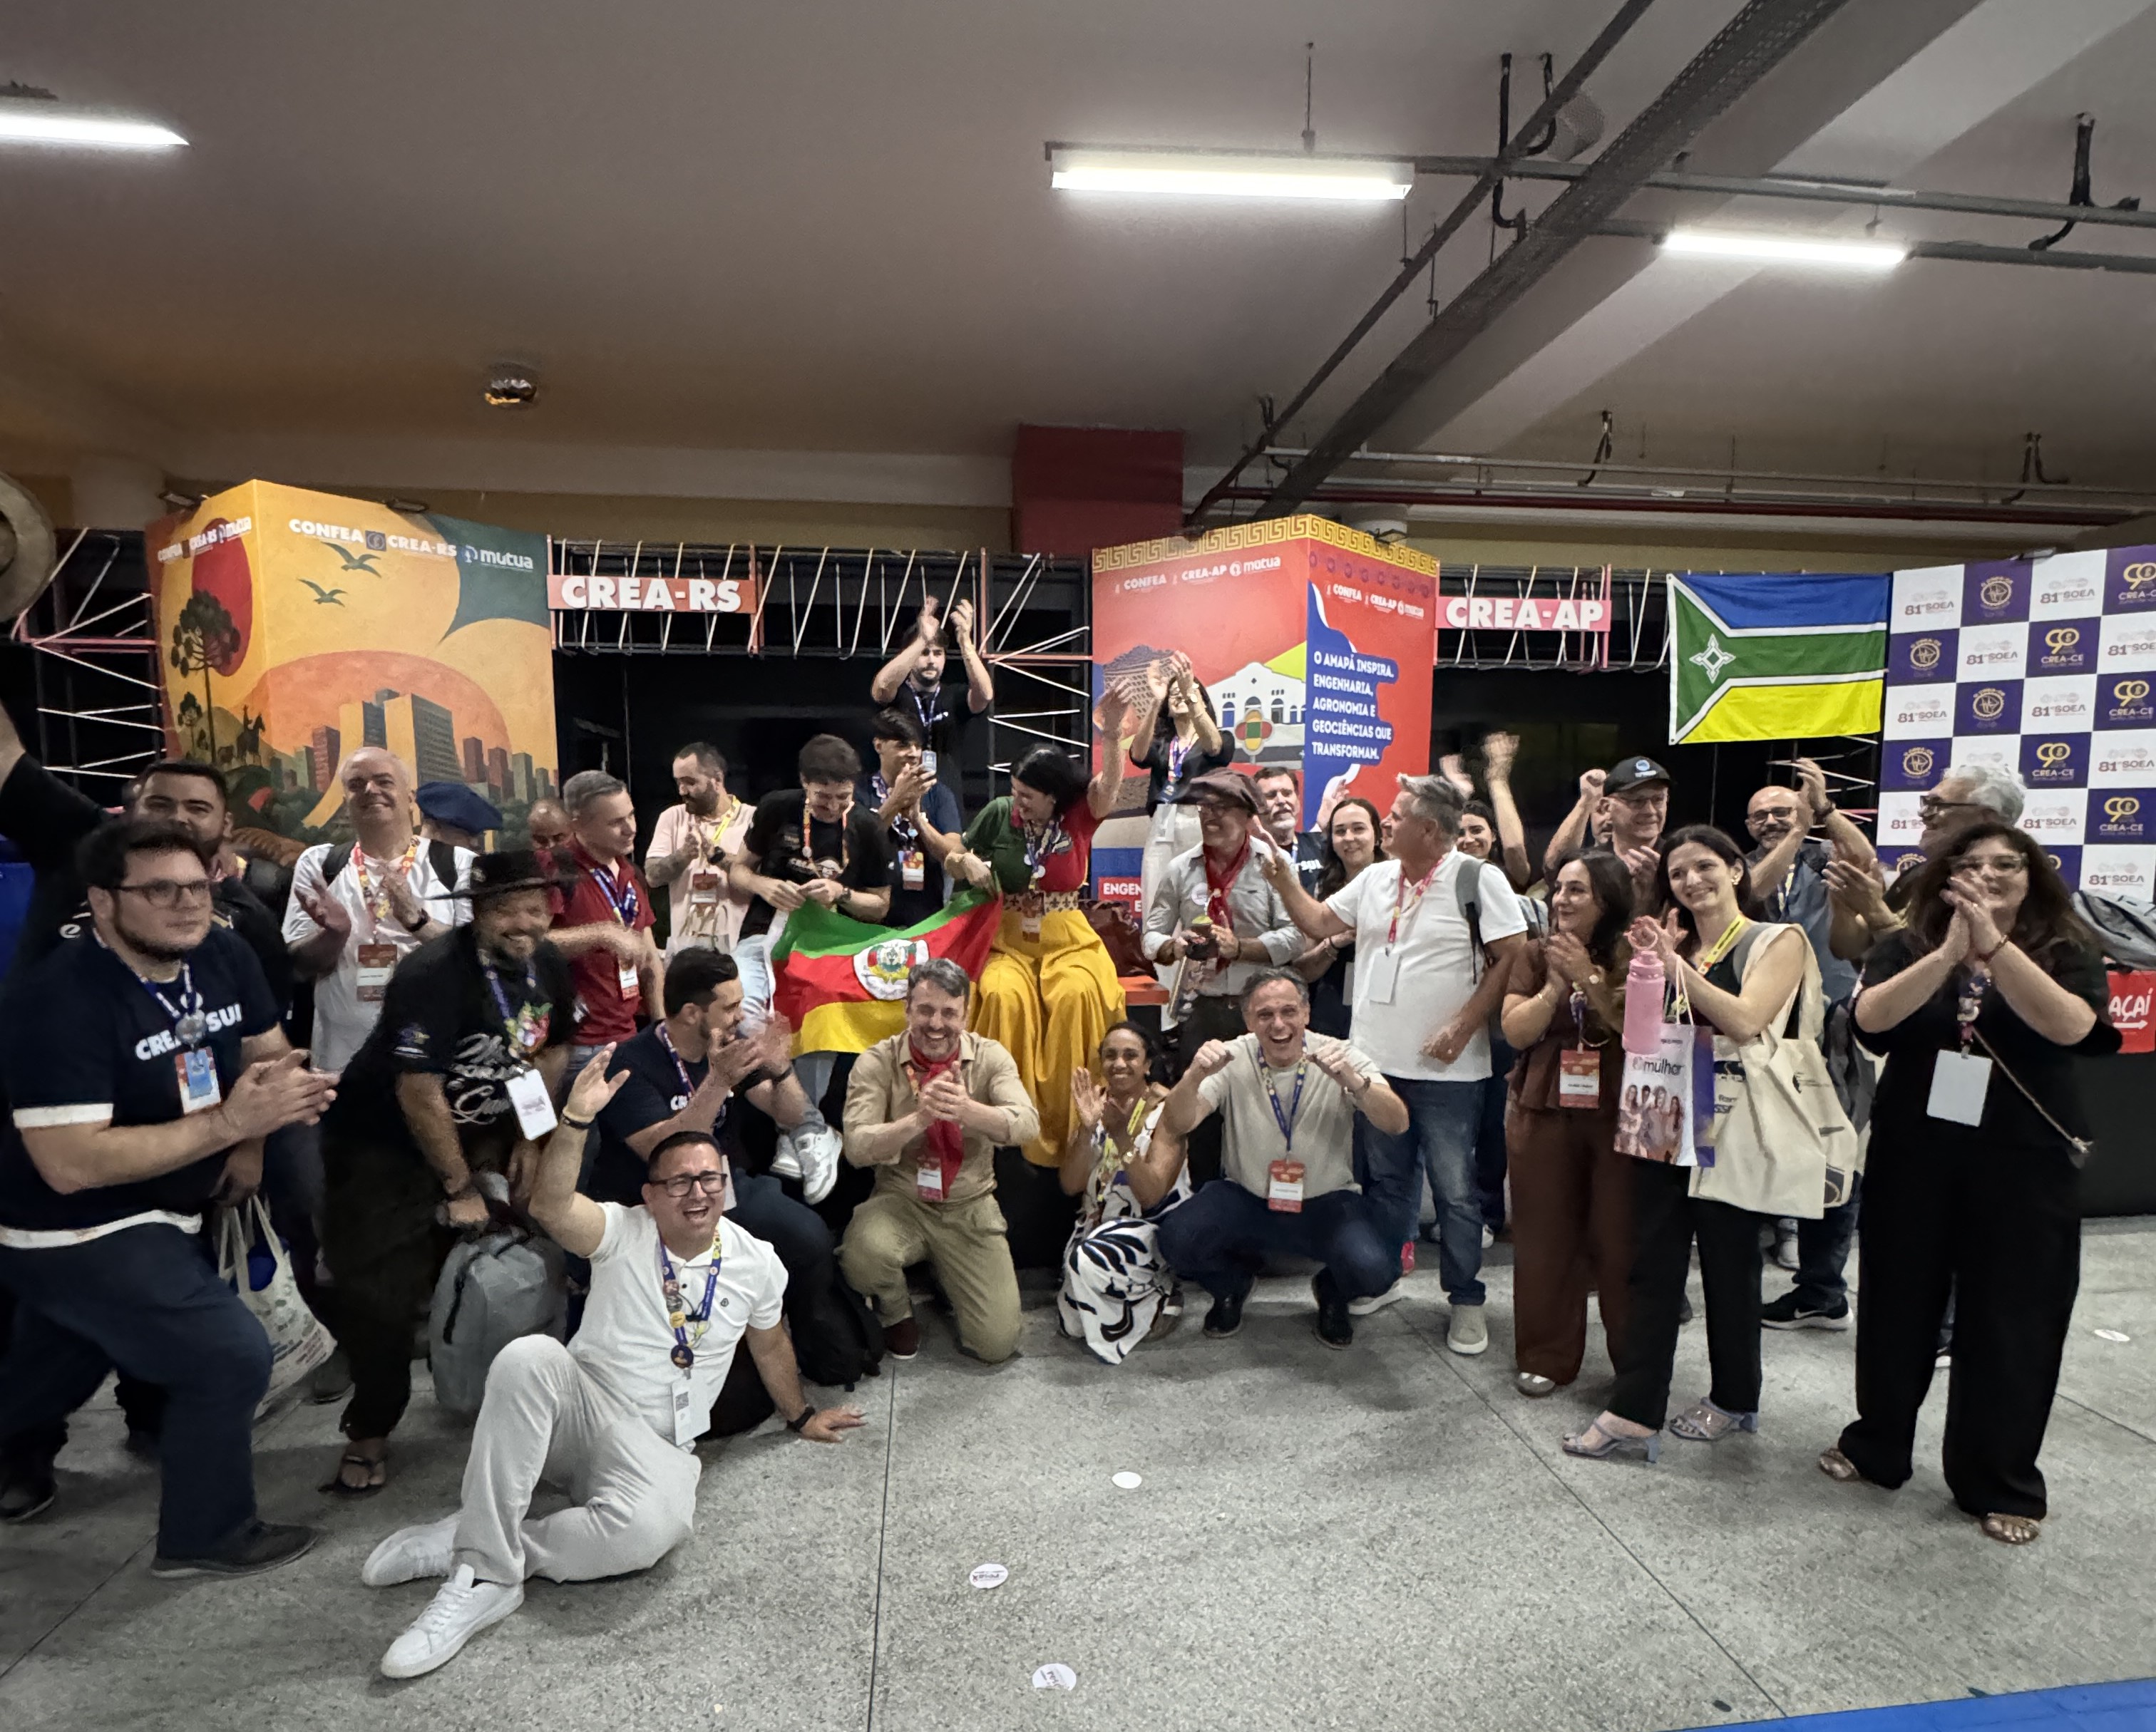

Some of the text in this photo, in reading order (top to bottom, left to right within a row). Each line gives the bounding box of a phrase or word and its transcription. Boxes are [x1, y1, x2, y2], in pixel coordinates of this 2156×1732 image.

[288, 518, 534, 569] CONFEA CREA-RS mutua
[1124, 574, 1167, 590] CONFEA
[1181, 565, 1227, 581] CREA-AP
[561, 575, 741, 613] CREA-RS
[1446, 597, 1603, 630] CREA-AP
[1313, 651, 1323, 664] O
[1323, 653, 1355, 671] AMAPÁ
[1313, 674, 1374, 696] ENGENHARIA,
[1312, 696, 1376, 717] AGRONOMIA E
[1312, 718, 1392, 741] GEOCIÊNCIAS QUE
[1312, 742, 1380, 760] TRANSFORMAM.
[2108, 988, 2153, 1022] AÇAÍ
